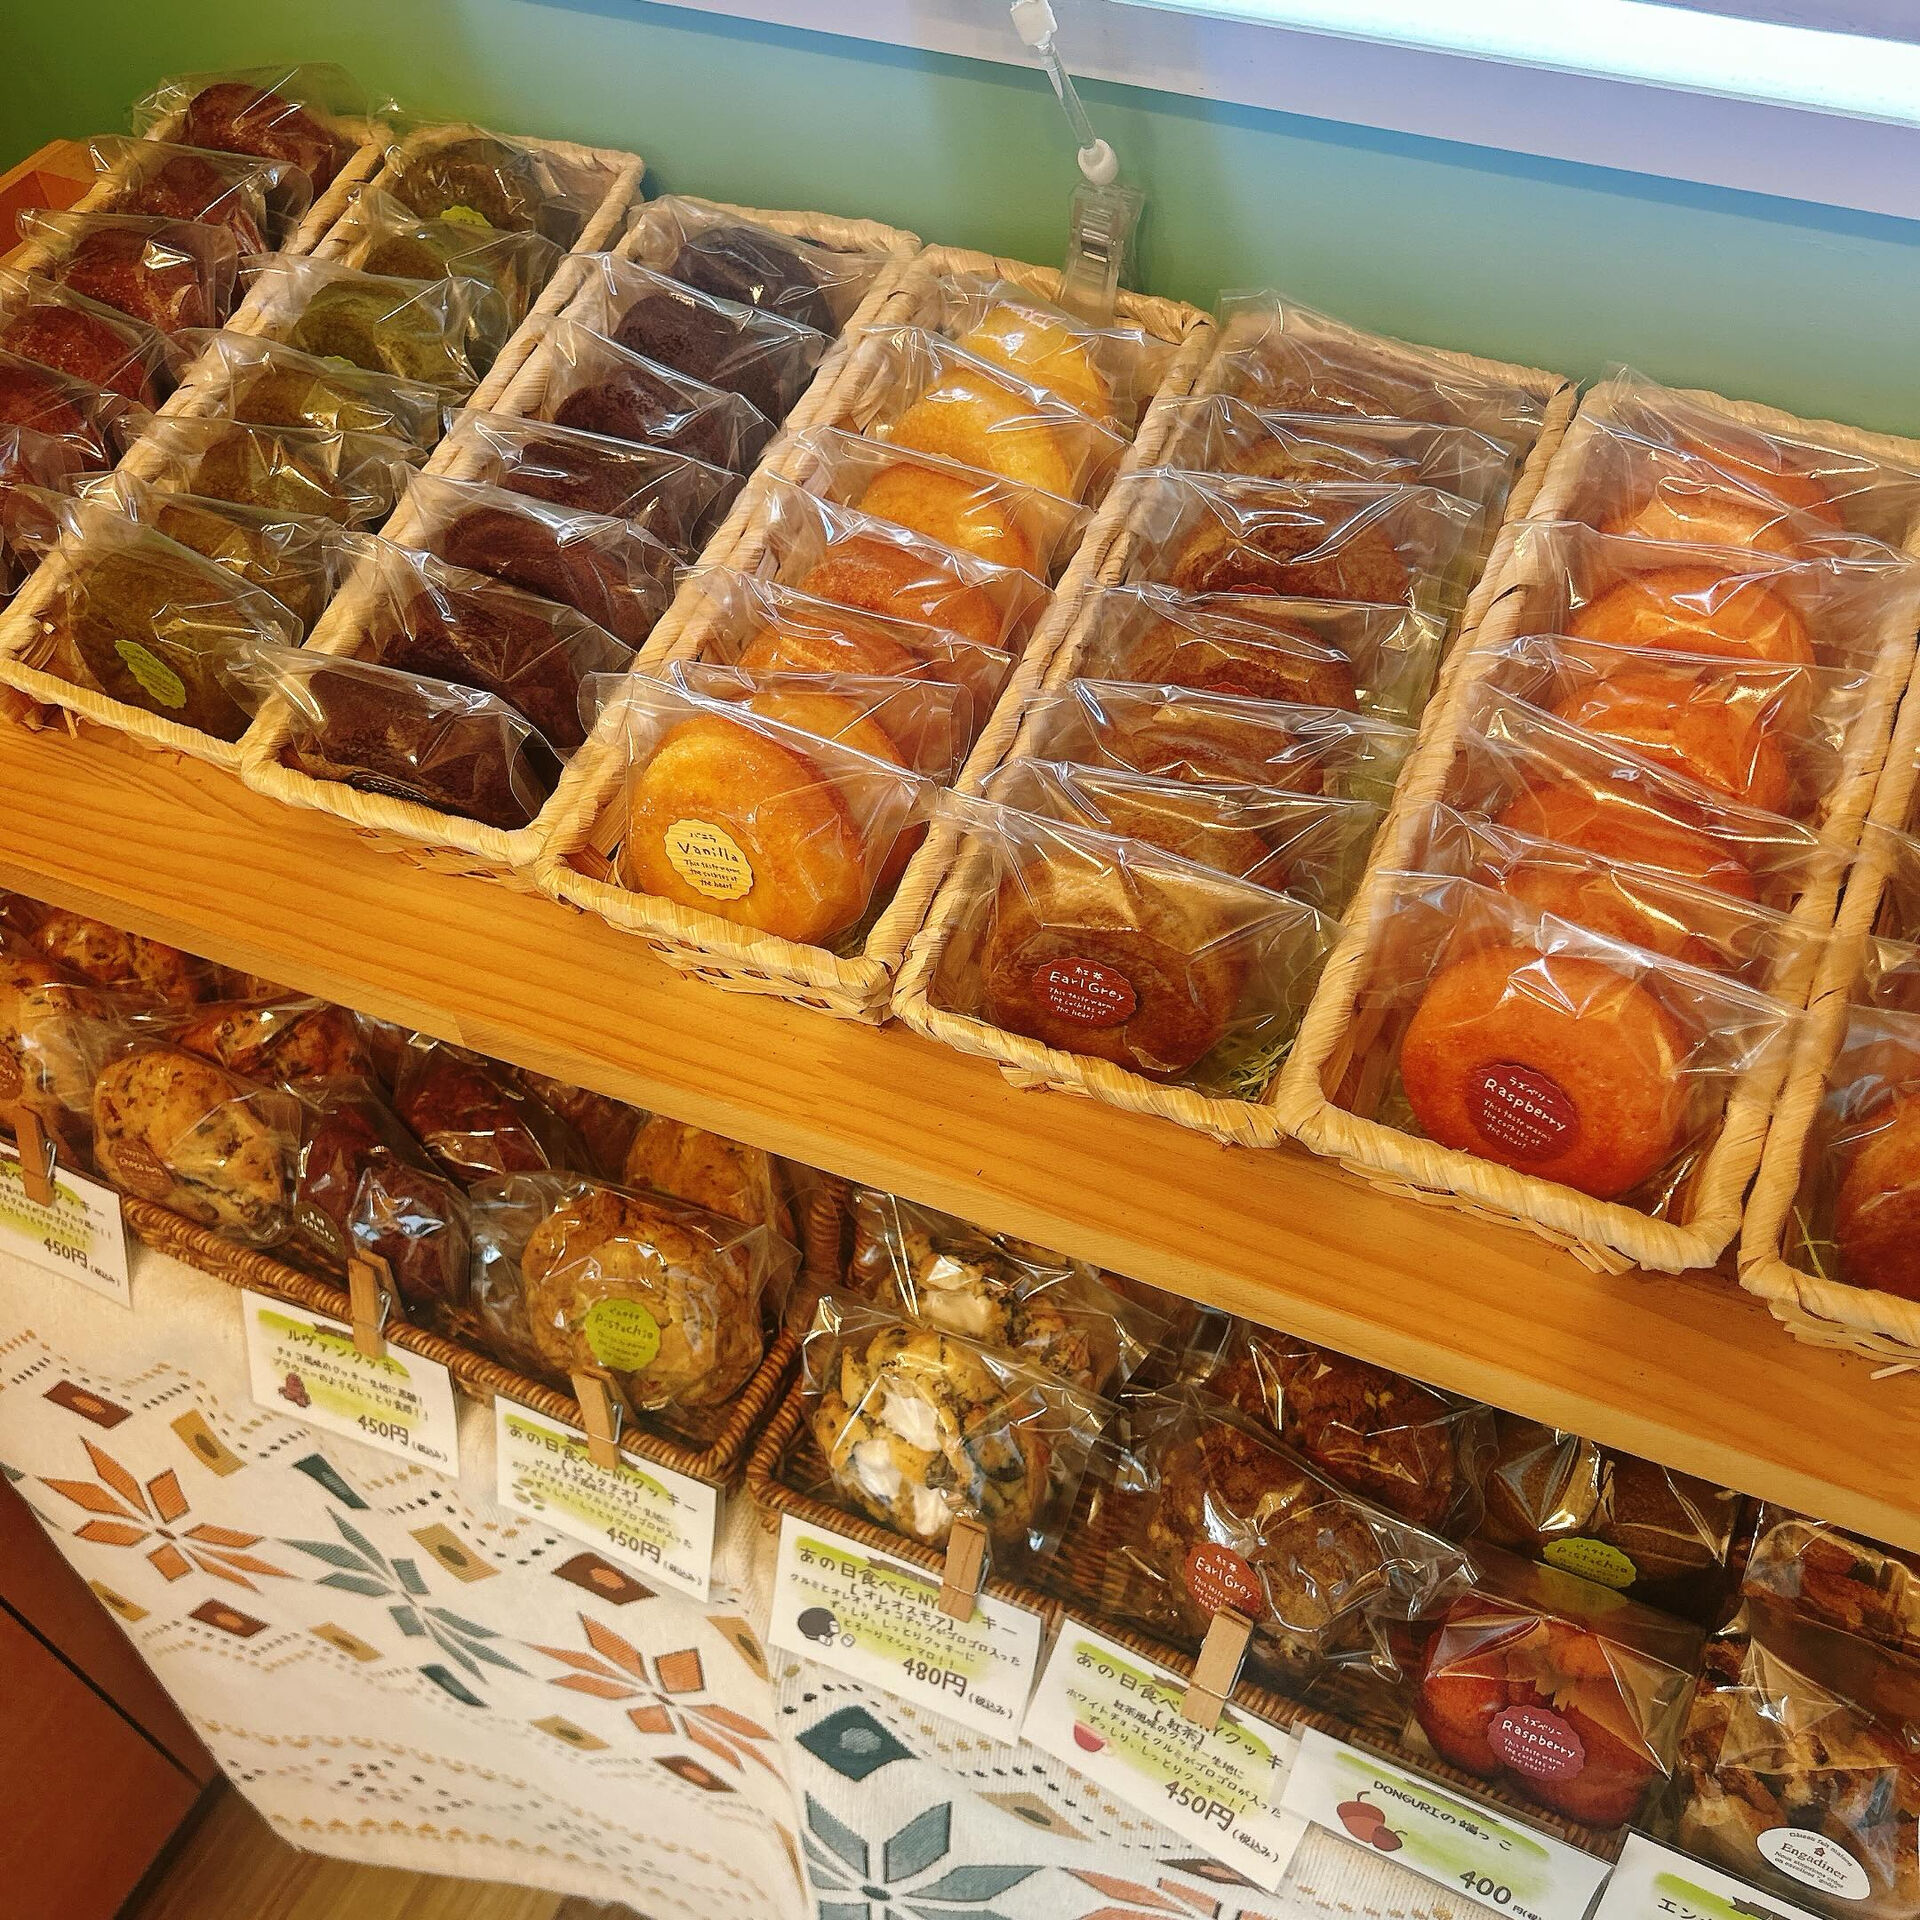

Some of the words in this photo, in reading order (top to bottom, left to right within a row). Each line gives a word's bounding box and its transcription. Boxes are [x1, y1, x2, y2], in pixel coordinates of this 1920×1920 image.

[677, 841, 739, 863] Vanilla
[1049, 971, 1085, 989] Earl
[1088, 982, 1125, 1002] Grey
[1484, 1078, 1566, 1132] Raspberry
[1509, 1076, 1554, 1104] ラズベリー
[43, 1237, 88, 1269] 450円
[595, 1313, 653, 1340] Pistachio
[357, 1414, 410, 1447] 450円
[606, 1526, 661, 1564] 450円
[799, 1547, 1019, 1636] あの日食べたNYキー
[1195, 1556, 1223, 1580] Earl
[1224, 1574, 1253, 1599] Grey
[902, 1657, 968, 1698] 480円
[1502, 1719, 1576, 1758] Raspberry
[1523, 1715, 1563, 1735] ラズベリー
[1164, 1779, 1235, 1832] 450円
[1780, 1842, 1848, 1880] Engadiner
[1459, 1870, 1512, 1906] 400
[1657, 1897, 1713, 1920] エン
